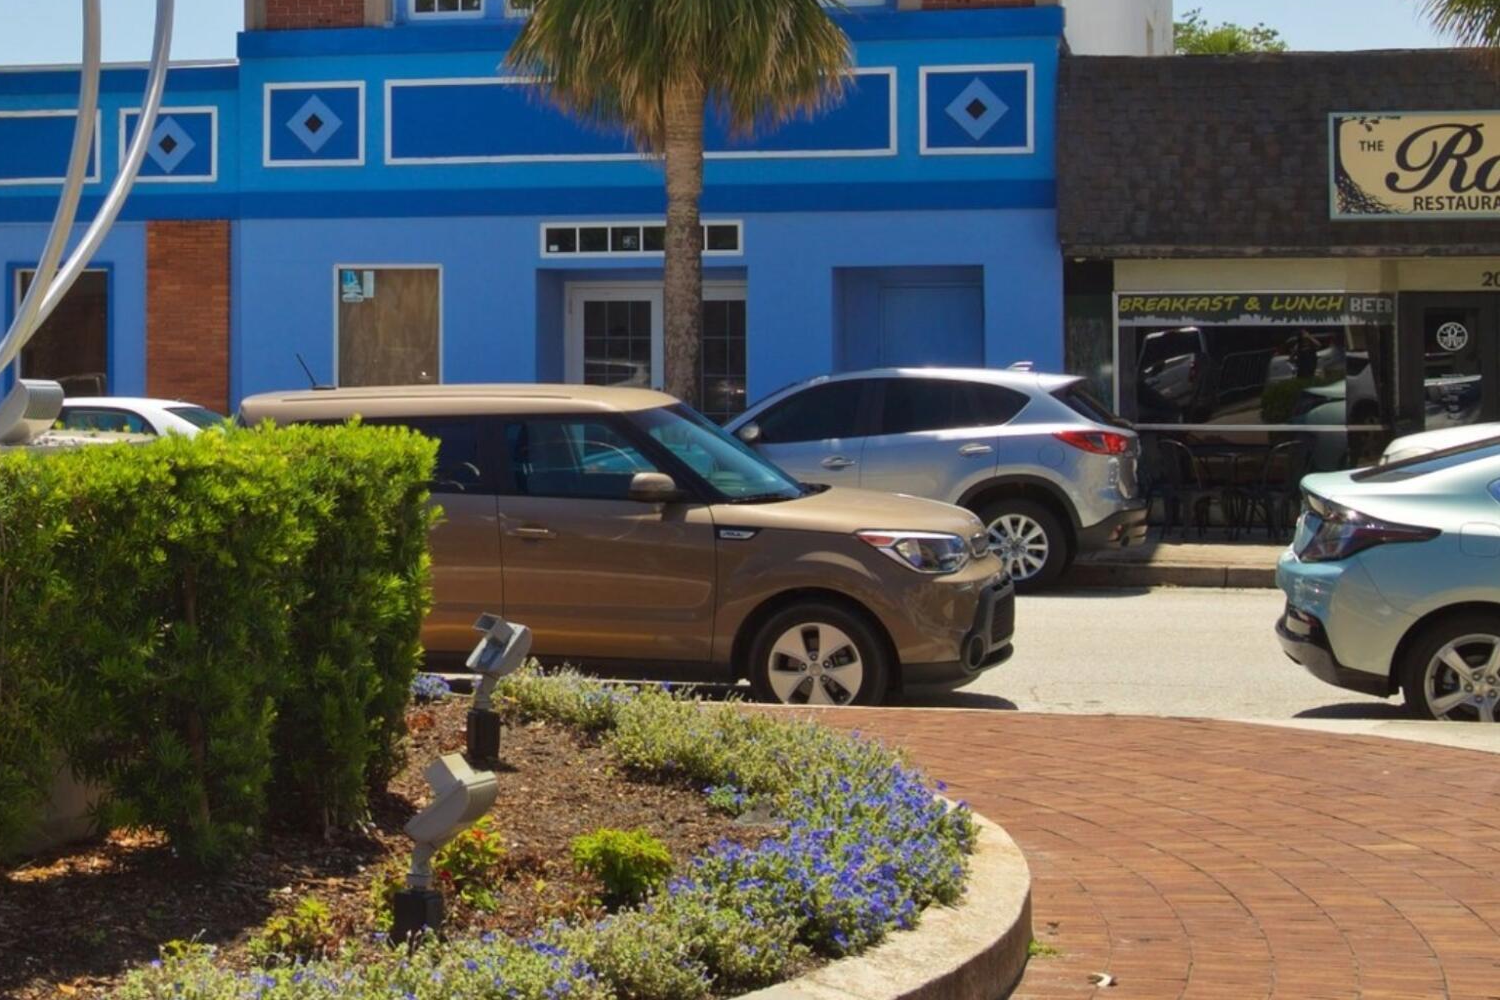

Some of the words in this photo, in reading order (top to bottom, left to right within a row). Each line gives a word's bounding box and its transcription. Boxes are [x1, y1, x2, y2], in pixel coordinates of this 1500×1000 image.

[1359, 140, 1385, 152] THE
[1118, 296, 1238, 312] BREAKFAST
[1244, 296, 1261, 311] &
[1270, 295, 1343, 311] LUNCH
